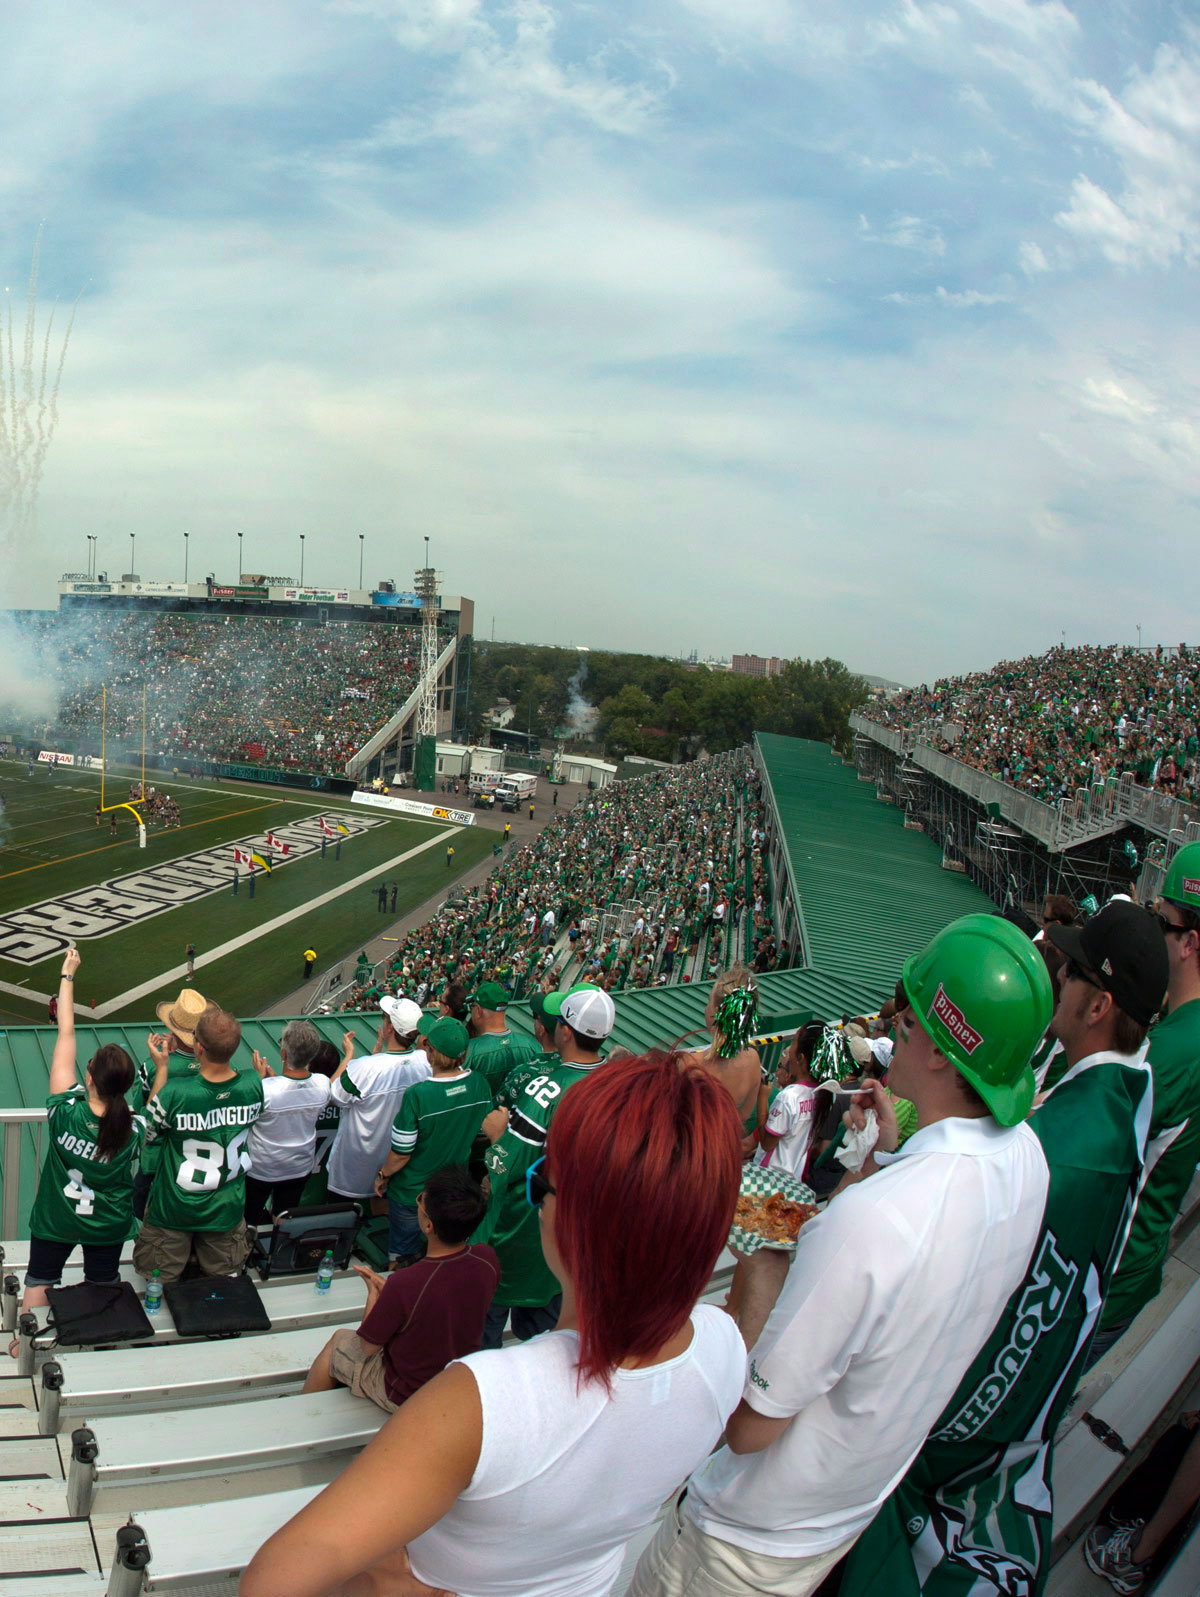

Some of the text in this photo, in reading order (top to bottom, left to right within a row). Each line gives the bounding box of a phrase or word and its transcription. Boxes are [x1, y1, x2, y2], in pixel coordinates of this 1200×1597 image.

[432, 807, 451, 820] OK
[453, 811, 471, 823] TIRE
[525, 1076, 561, 1109] 82
[176, 1102, 262, 1132] DOMINGUEZ
[63, 1169, 95, 1215] 4
